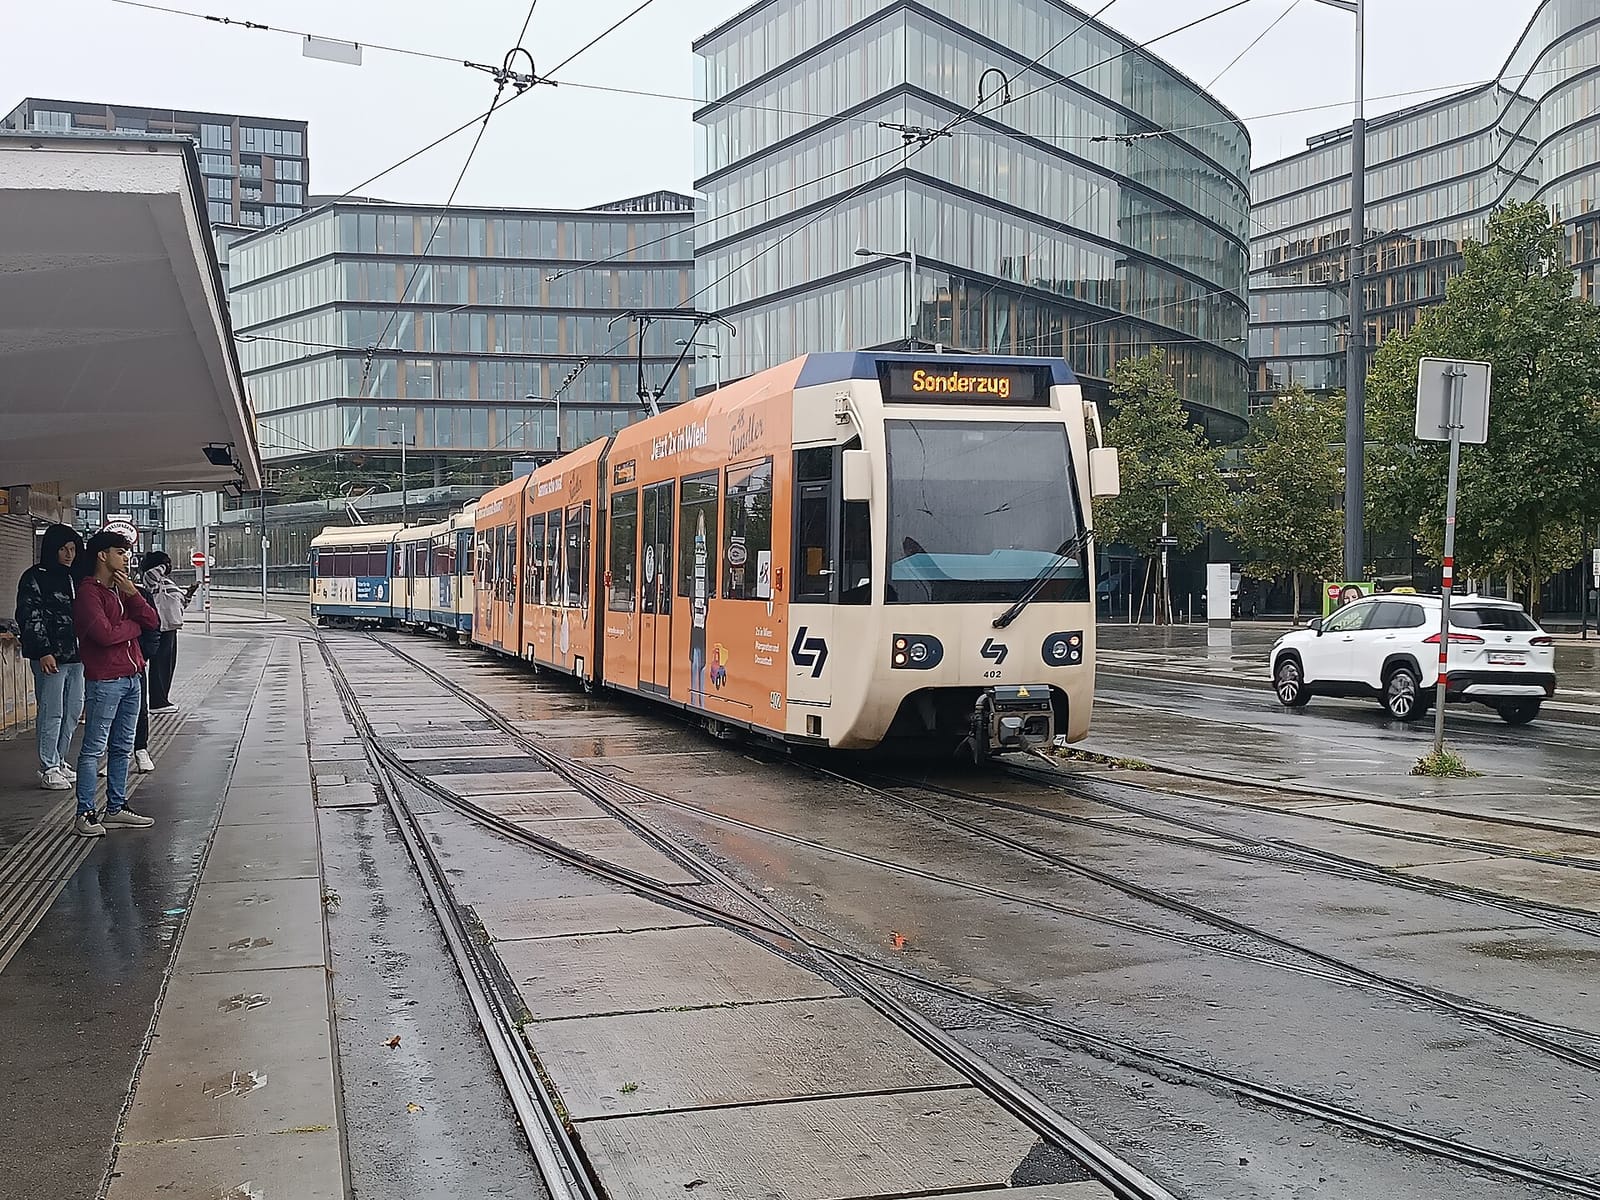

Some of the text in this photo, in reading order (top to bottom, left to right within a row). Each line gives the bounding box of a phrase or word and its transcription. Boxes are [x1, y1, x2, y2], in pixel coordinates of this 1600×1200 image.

[911, 369, 1011, 399] Sonderzug
[651, 418, 708, 461] Jetzt 2x in Wien!
[983, 670, 1002, 679] 402
[770, 691, 782, 711] 402
